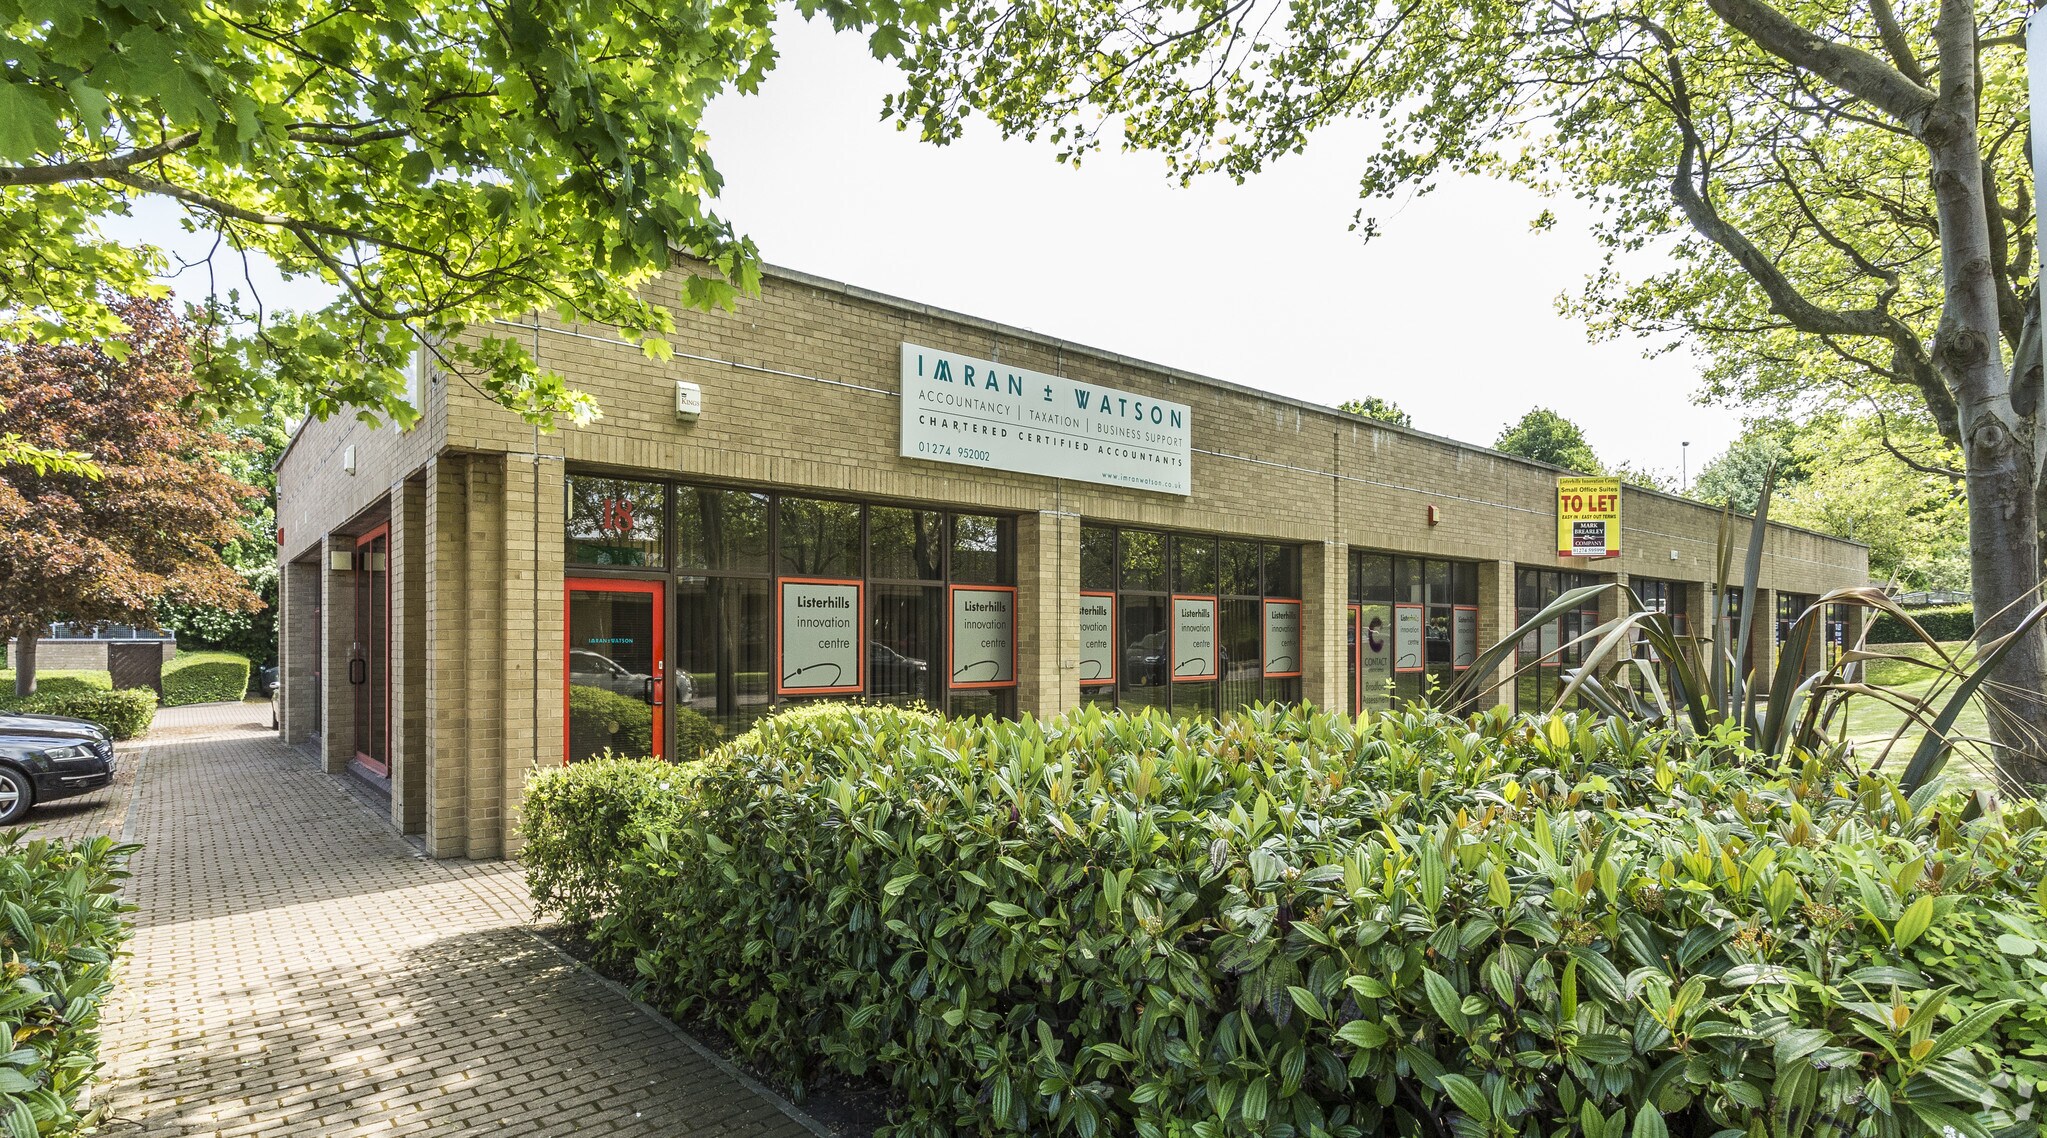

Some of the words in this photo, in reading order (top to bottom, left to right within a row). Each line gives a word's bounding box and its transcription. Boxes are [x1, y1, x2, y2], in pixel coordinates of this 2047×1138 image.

[918, 354, 1022, 397] IMRAN
[1074, 389, 1182, 429] WATSON
[918, 389, 1011, 416] ACCOUNTANCY
[1029, 409, 1080, 428] TAXATION
[1097, 423, 1141, 440] BUSINESS
[1145, 432, 1183, 447] SUPPORT
[919, 415, 1007, 438] CHARTERED
[1018, 431, 1089, 451] CERTIFIED
[1098, 445, 1182, 467] ACCOUNTANTS
[918, 441, 951, 456] 01274
[958, 447, 990, 462] 952002
[1102, 472, 1182, 490] www.imranwatson.co.uk
[1561, 495, 1583, 512] TO
[1588, 495, 1617, 512] LET
[602, 499, 633, 532] 18
[797, 596, 850, 609] Listerhills
[964, 601, 1006, 613] Listerhills
[1079, 605, 1107, 616] sterhills
[1181, 609, 1210, 618] Listerhills
[797, 616, 850, 628] innovation
[964, 619, 1006, 630] innovation
[1181, 623, 1210, 632] innovation
[818, 638, 850, 649] centre
[981, 638, 1006, 648] centre
[1086, 640, 1107, 648] centre
[1193, 640, 1210, 648] centre
[1364, 657, 1387, 666] CONTACT
